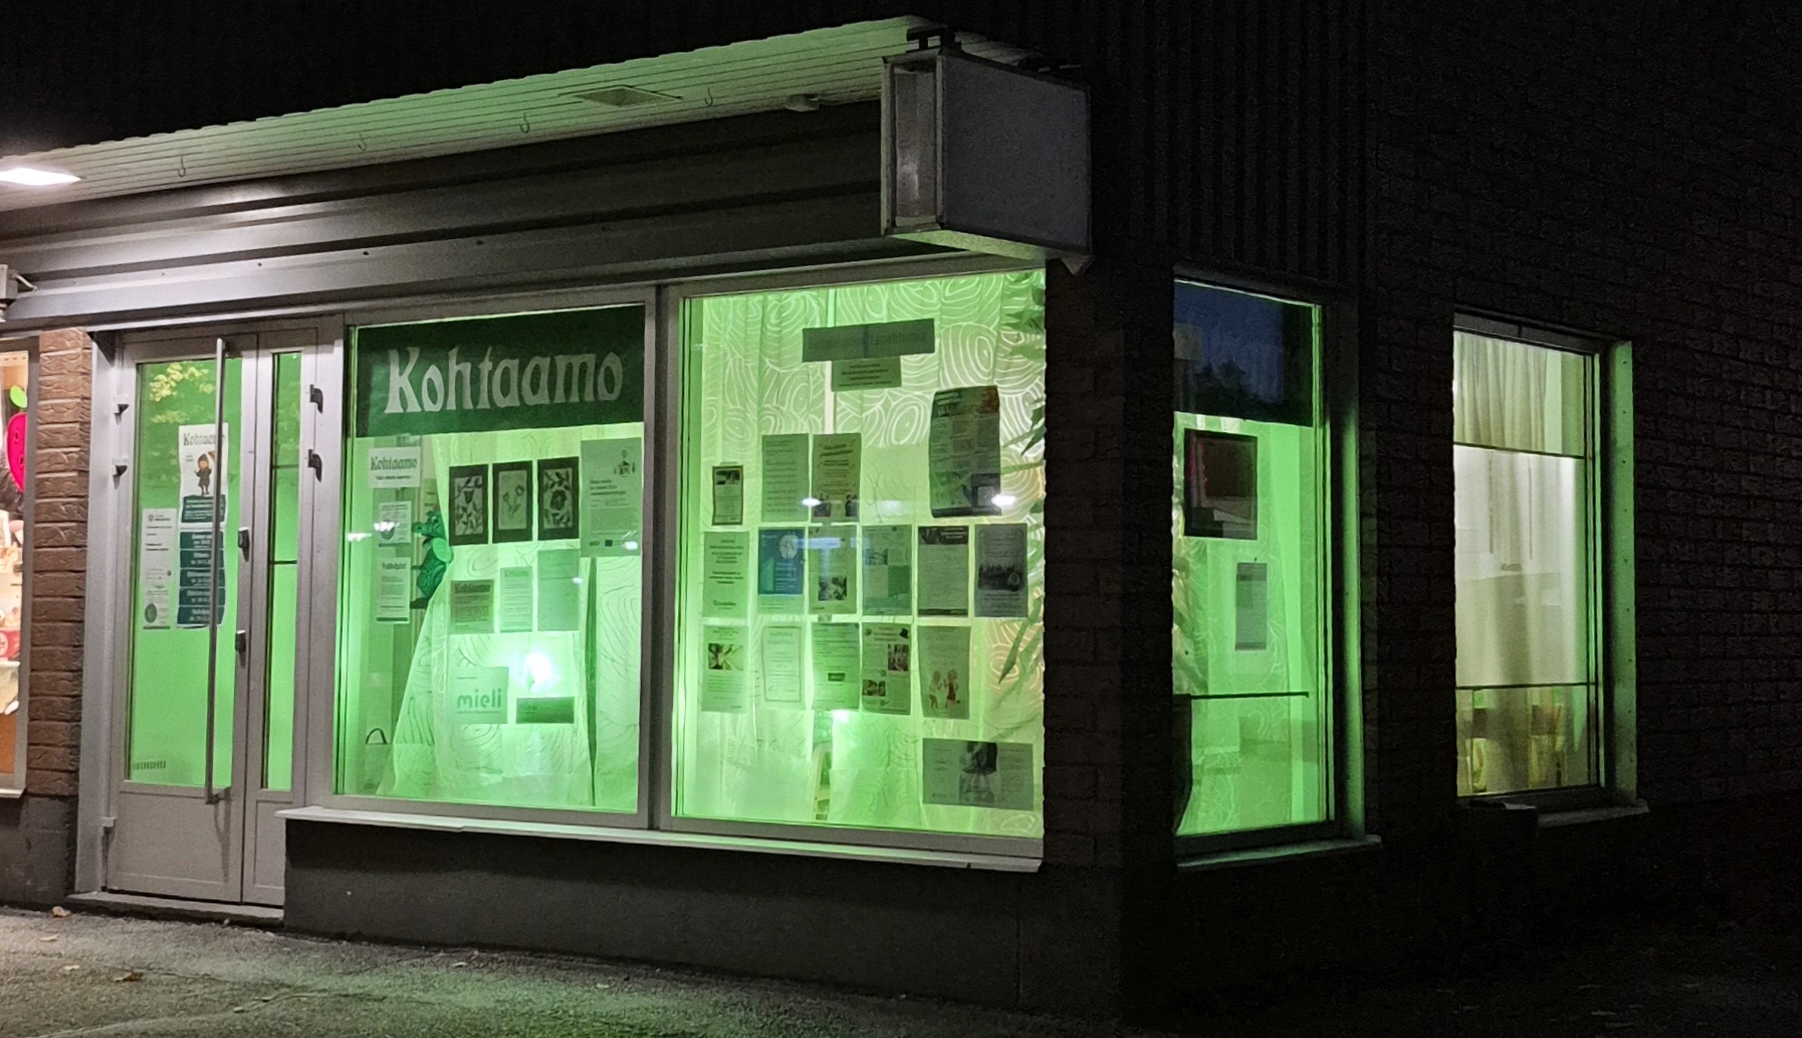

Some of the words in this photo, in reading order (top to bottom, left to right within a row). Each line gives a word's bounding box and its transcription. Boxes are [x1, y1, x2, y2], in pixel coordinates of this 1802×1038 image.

[384, 346, 624, 414] Kohtaamo
[370, 456, 418, 471] Kohtaamo
[456, 688, 502, 708] mieli
